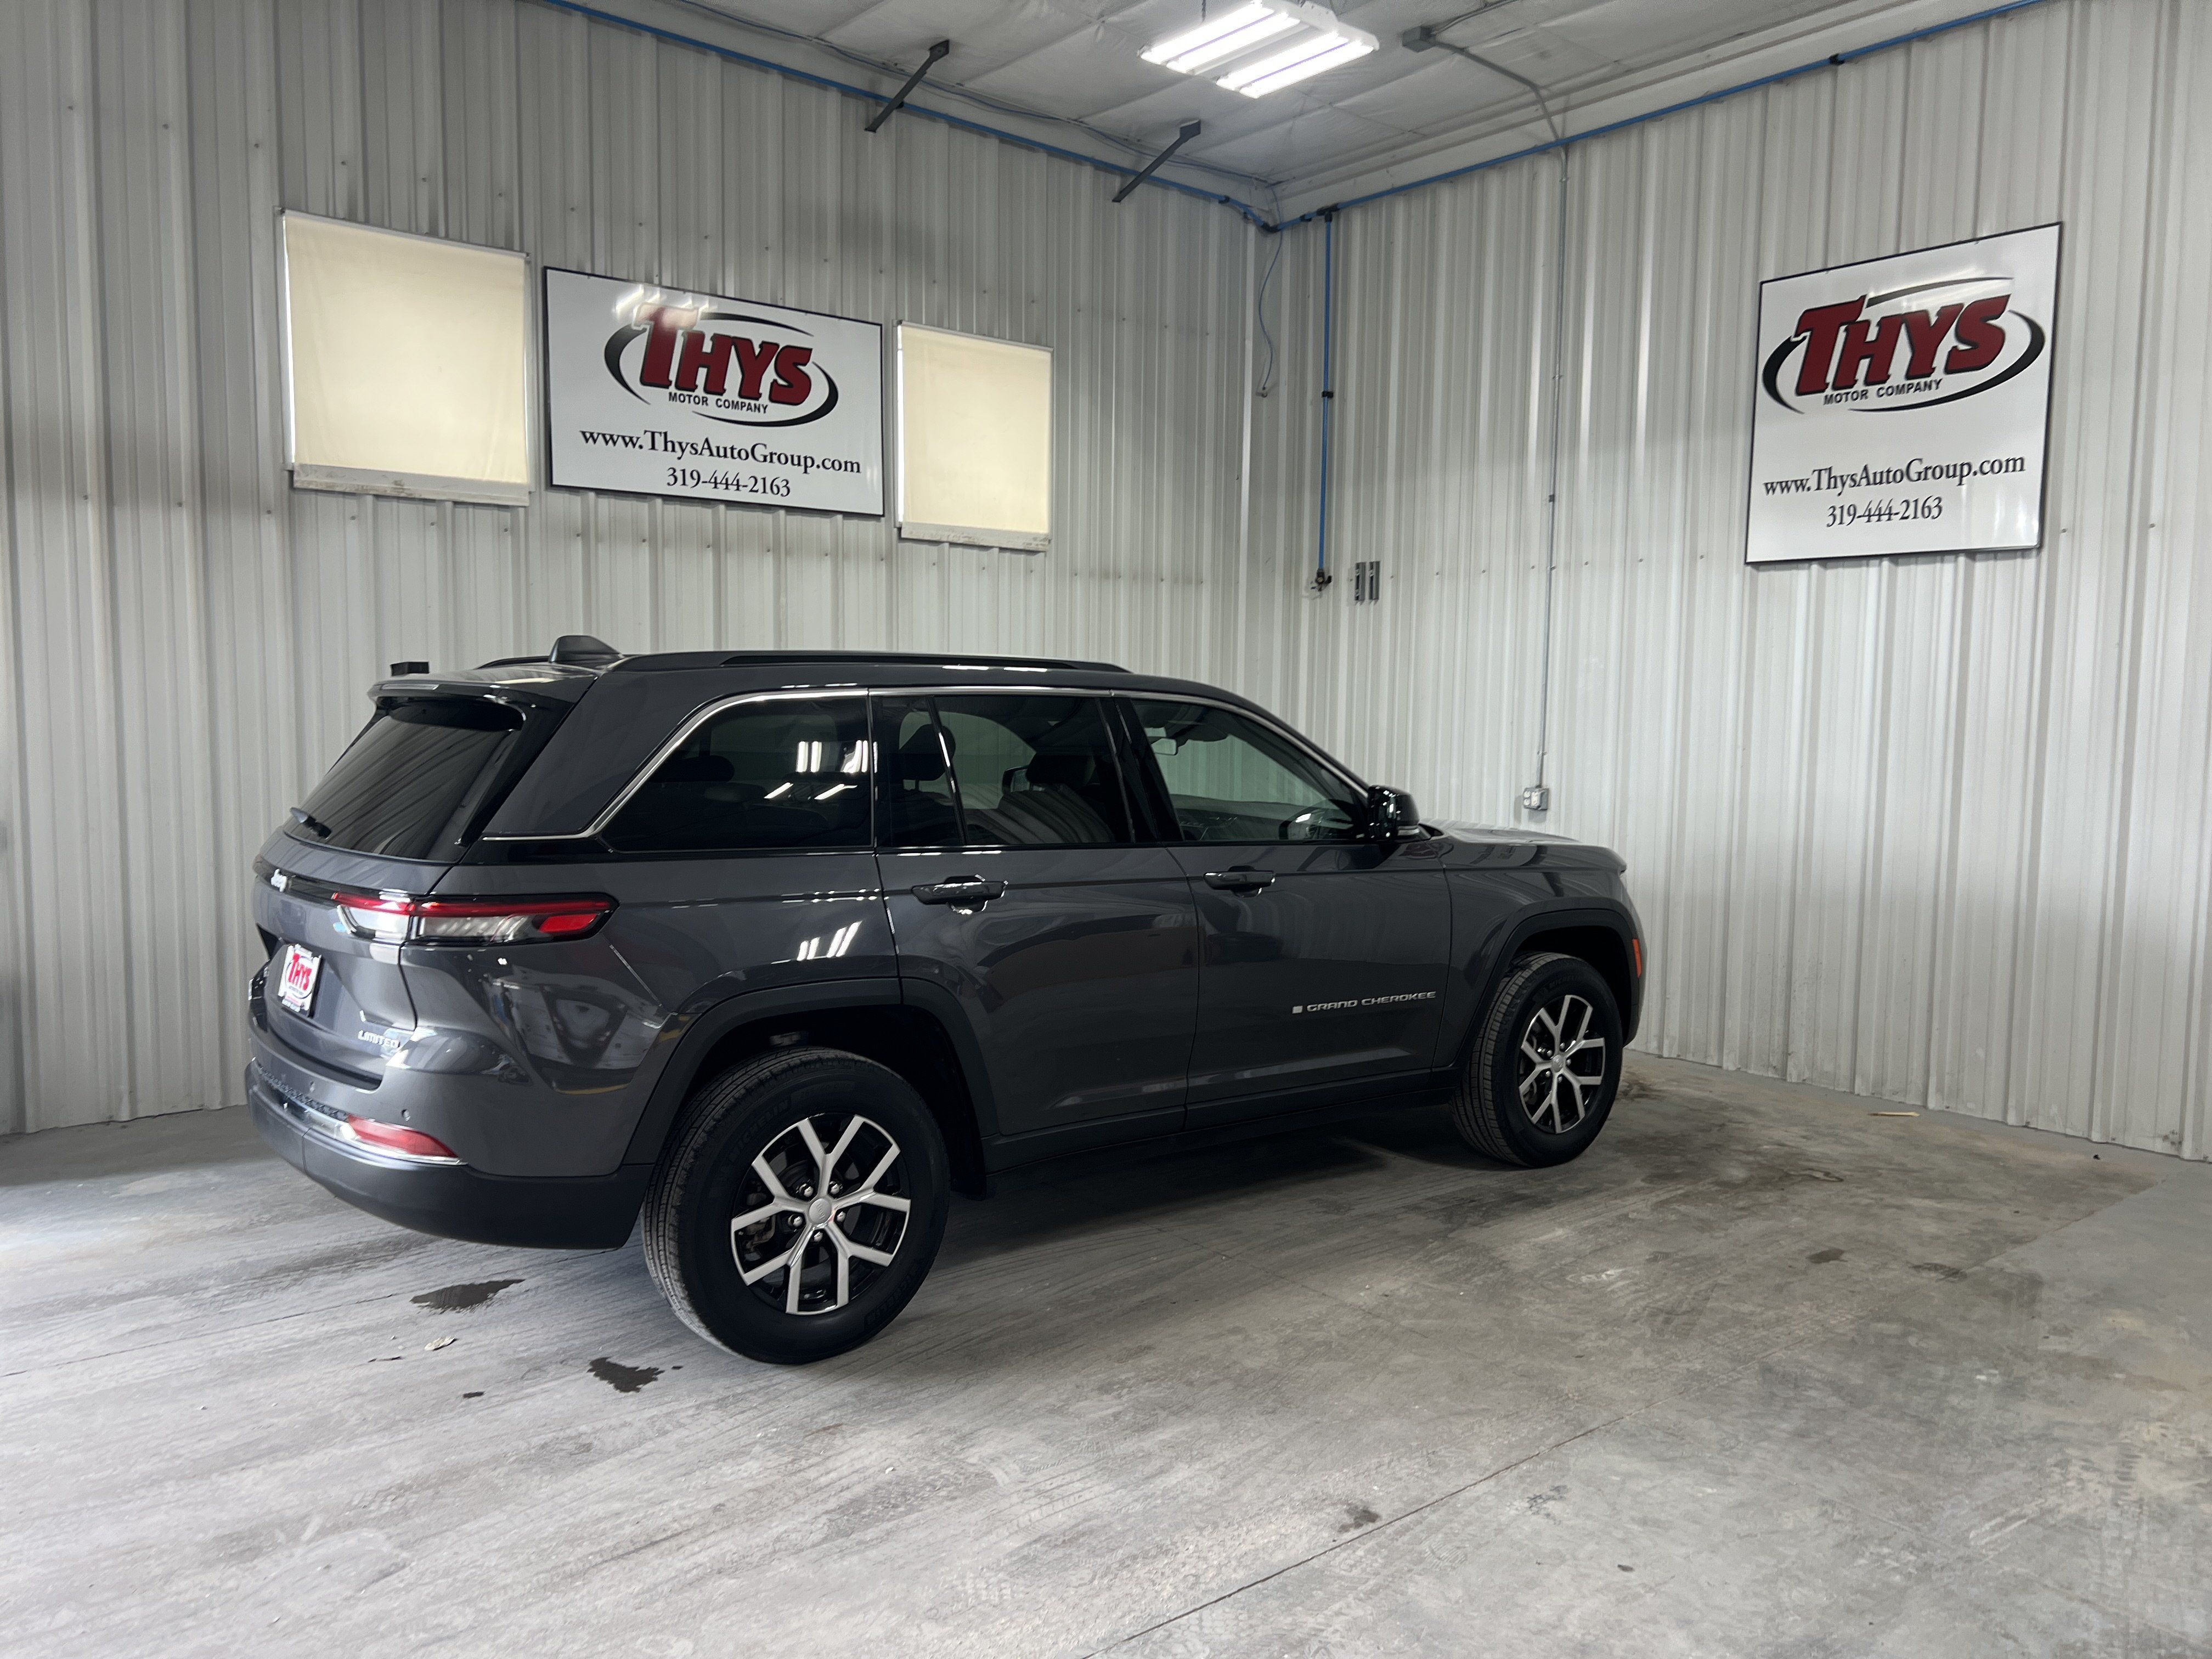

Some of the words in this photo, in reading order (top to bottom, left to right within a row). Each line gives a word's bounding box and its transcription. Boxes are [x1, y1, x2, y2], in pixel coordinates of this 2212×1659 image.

[631, 302, 813, 407] THYS
[1792, 294, 2012, 396] THYS
[668, 392, 708, 407] MOTOR
[715, 398, 769, 414] COMPANY
[1823, 390, 1869, 405] MOTOR
[1876, 378, 1943, 398] COMPANY
[579, 430, 861, 475] www.ThysAutoGroup.com
[667, 467, 791, 498] 319-444-2163
[1763, 456, 2025, 496] www.ThysAutoGroup.com
[1826, 495, 1943, 527] 319-444-2163
[288, 953, 312, 991] THYS
[1306, 1000, 1358, 1012] GRAND
[1361, 991, 1436, 1006] CHEROKEE
[358, 1030, 399, 1048] LIMITED
